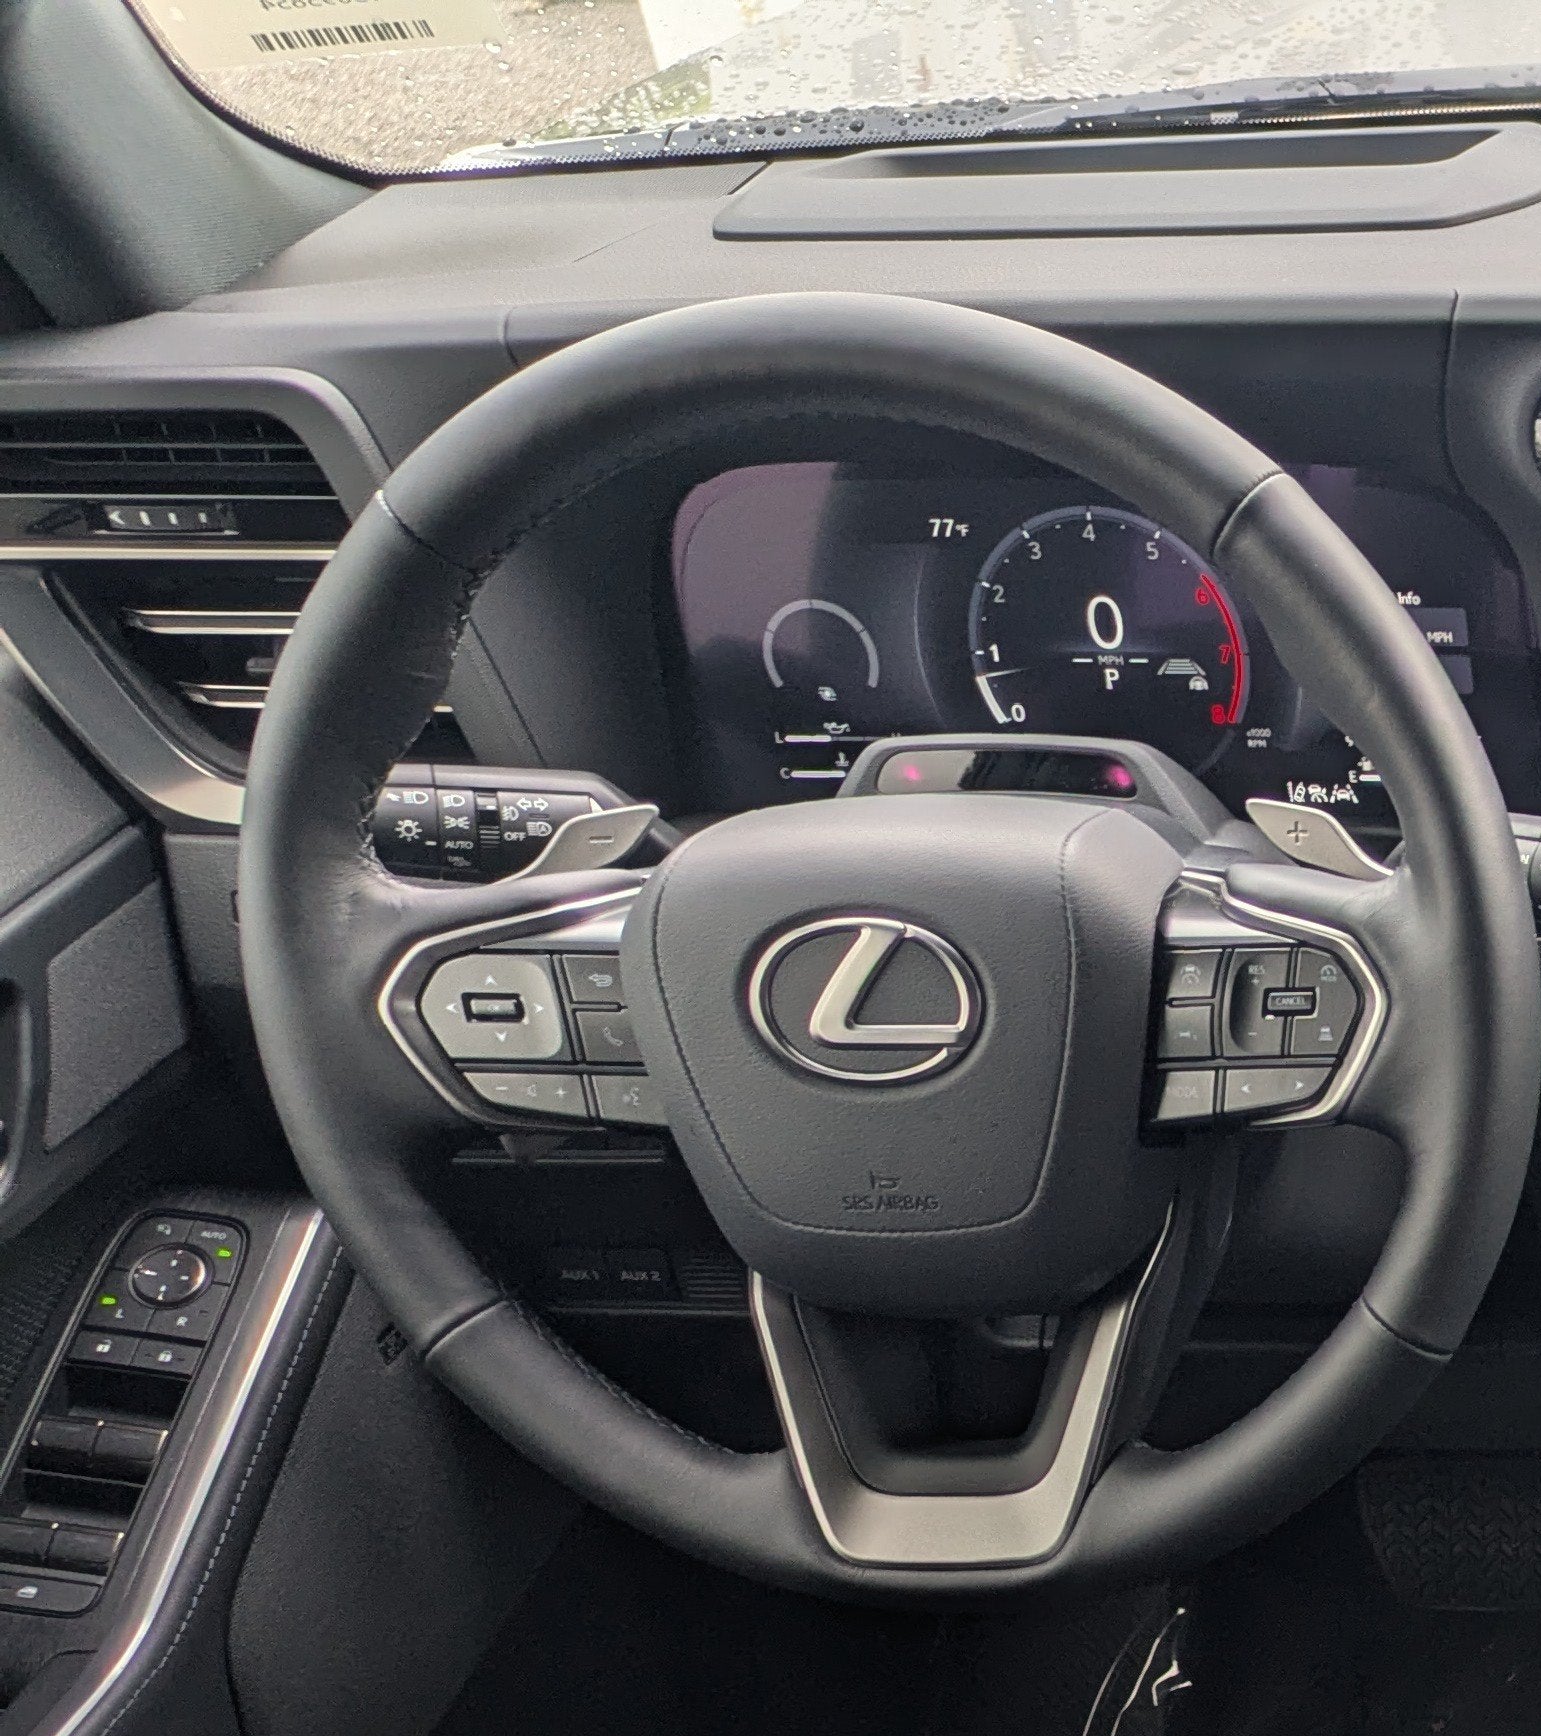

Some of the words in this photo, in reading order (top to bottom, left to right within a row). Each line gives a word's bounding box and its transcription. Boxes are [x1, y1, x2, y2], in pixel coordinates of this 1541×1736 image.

[1081, 523, 1096, 541] 4
[1027, 541, 1042, 560] 3
[1146, 541, 1160, 560] 5
[992, 584, 1006, 603] 2
[1196, 587, 1210, 604] 6
[1087, 595, 1124, 650] 0
[989, 643, 1000, 663] 1
[1097, 655, 1124, 666] MPH
[1218, 644, 1231, 664] 7
[1103, 668, 1120, 690] P
[1010, 702, 1026, 722] 0
[1210, 704, 1225, 724] 8
[444, 840, 474, 850] AUTO
[503, 831, 526, 842] OFF
